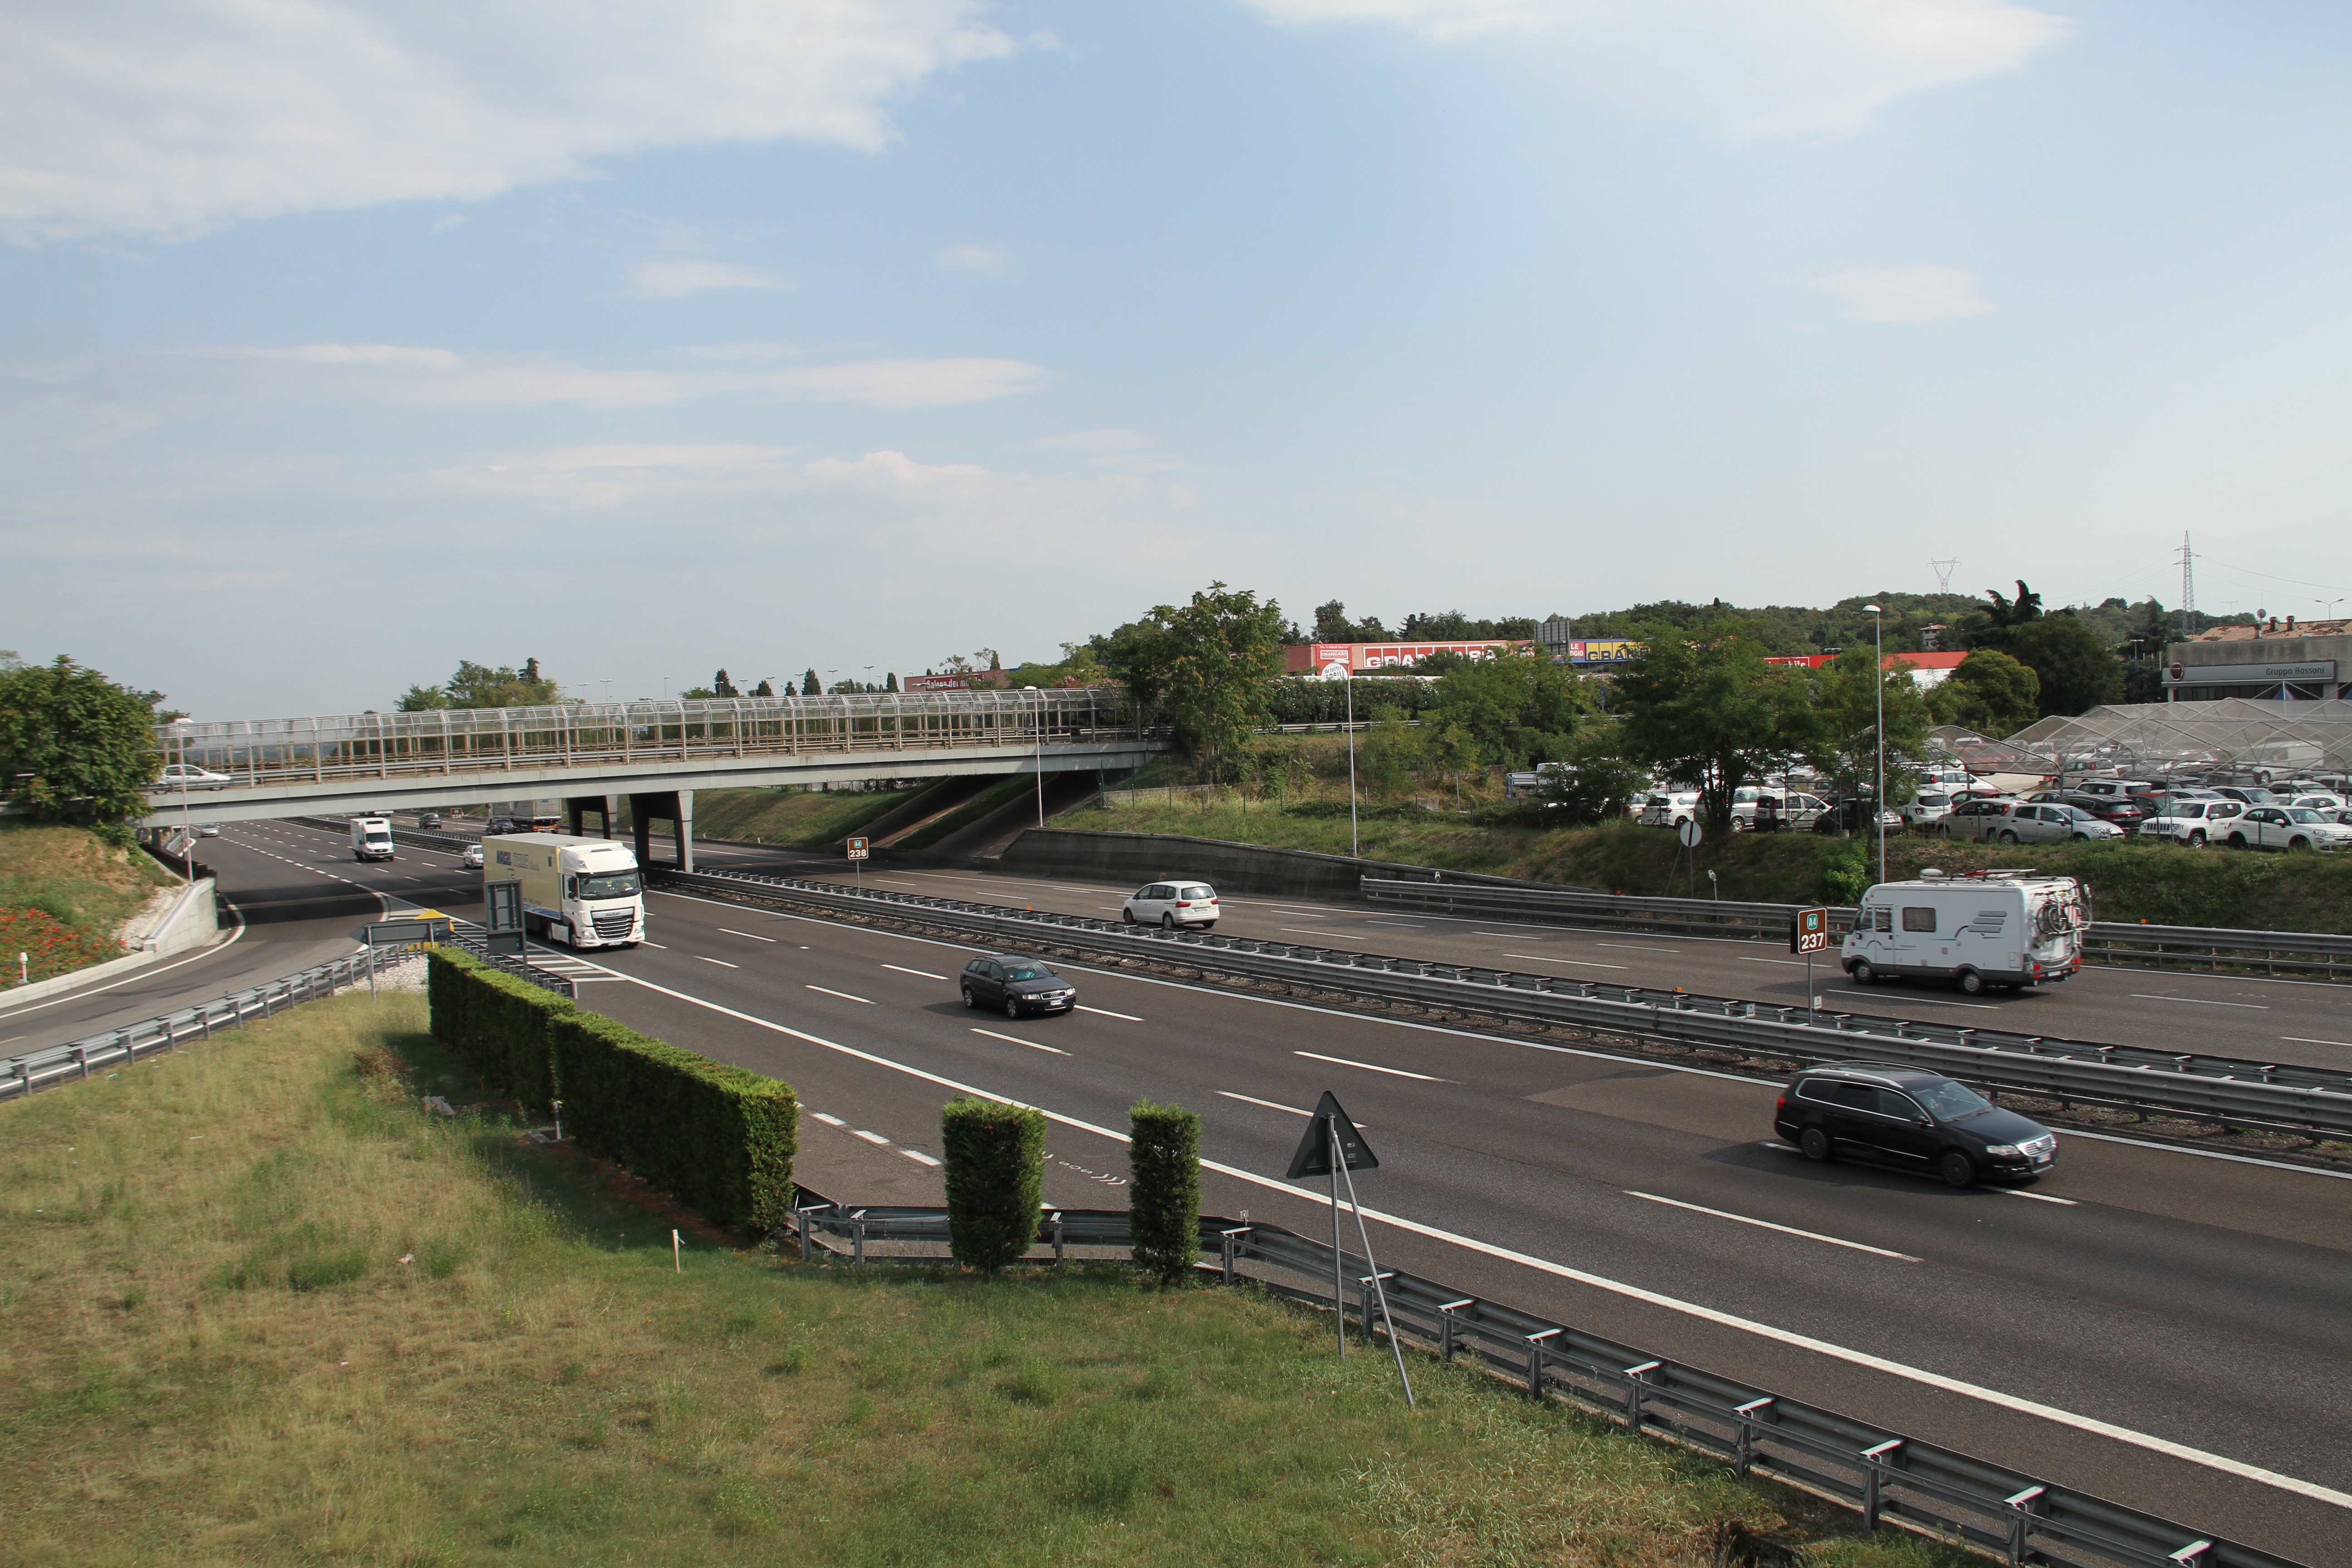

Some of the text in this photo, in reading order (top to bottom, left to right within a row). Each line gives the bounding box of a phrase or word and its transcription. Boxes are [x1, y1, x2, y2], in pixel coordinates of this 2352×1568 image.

[2266, 666, 2324, 676] Gruppo Bossoni
[849, 849, 867, 858] 238
[1808, 917, 1817, 926] A4
[1801, 932, 1824, 950] 237
